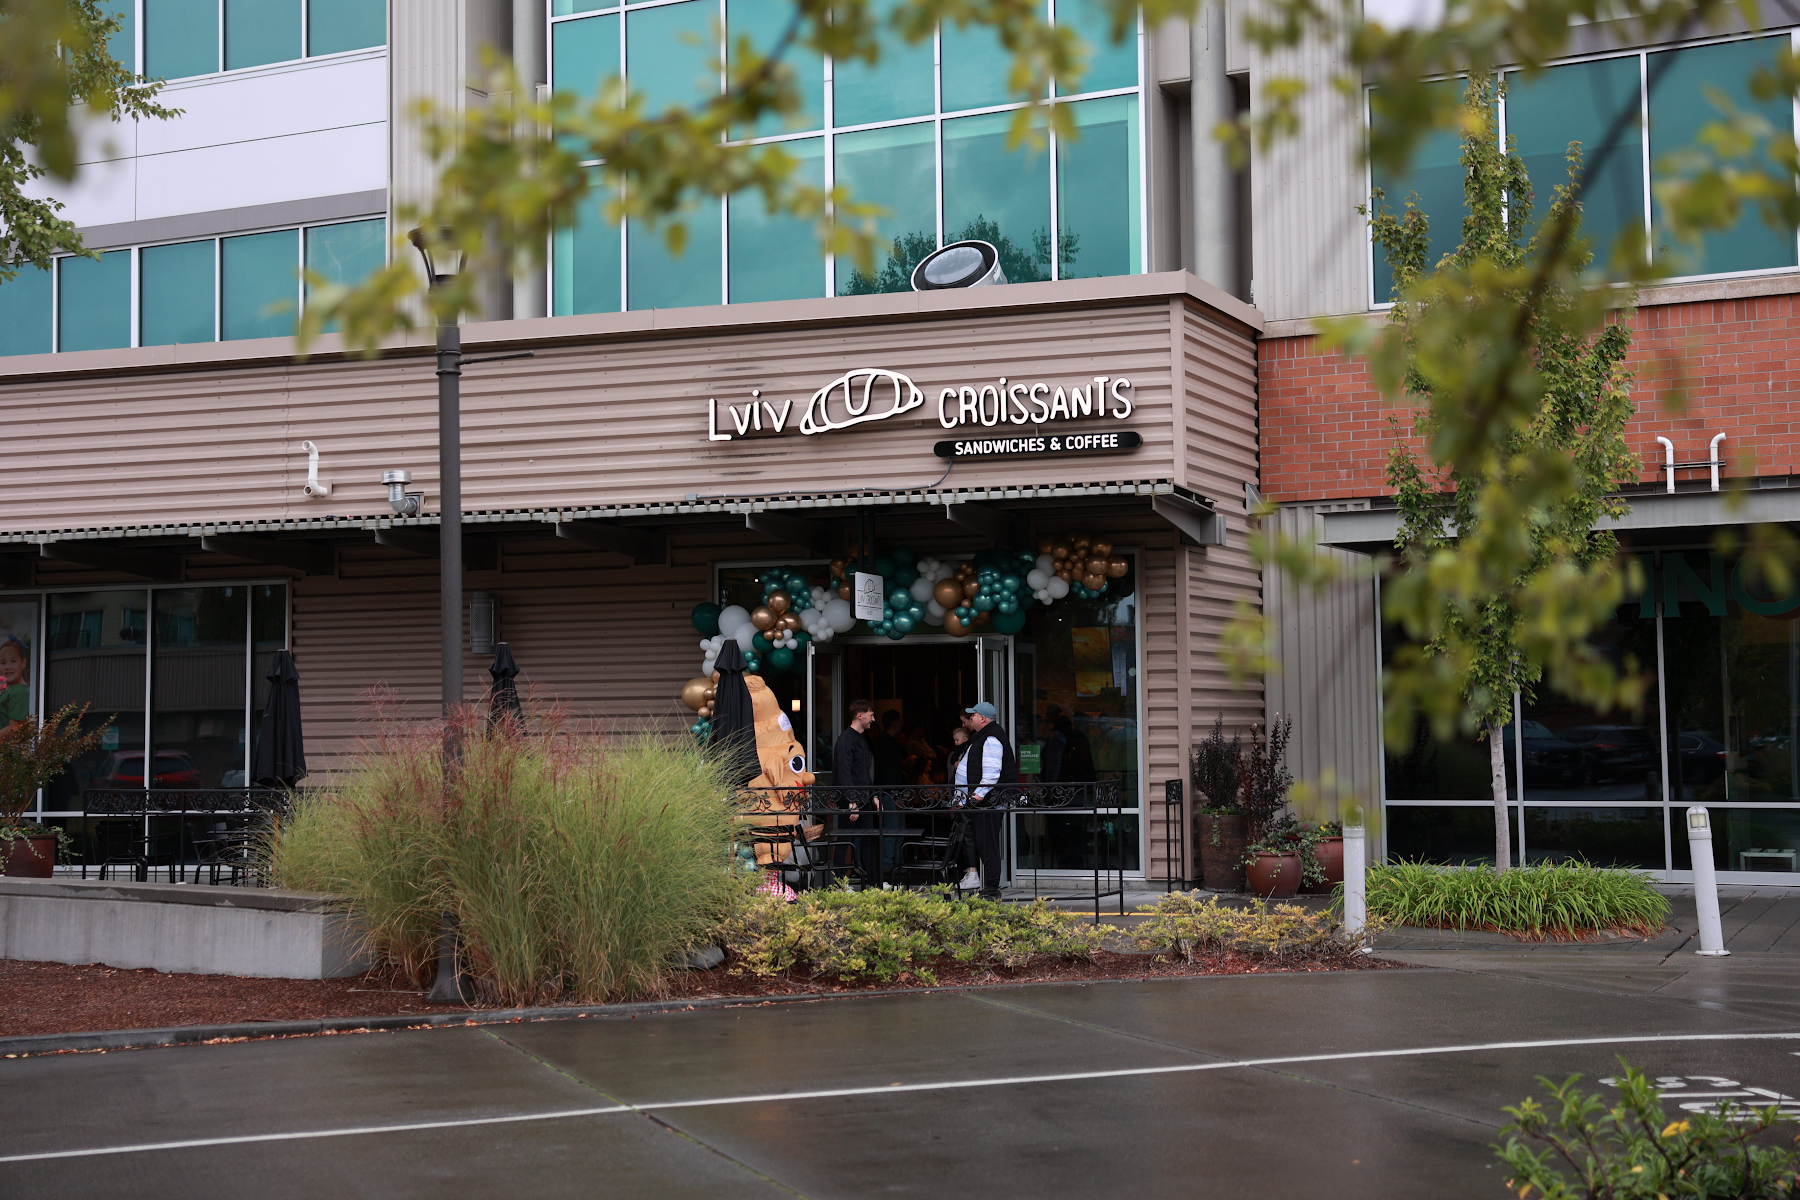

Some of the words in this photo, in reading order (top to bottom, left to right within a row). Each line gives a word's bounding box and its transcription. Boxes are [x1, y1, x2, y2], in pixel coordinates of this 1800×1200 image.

[955, 438, 1046, 456] SANDWICHES
[1050, 436, 1062, 451] &
[1066, 434, 1119, 450] COFFEE
